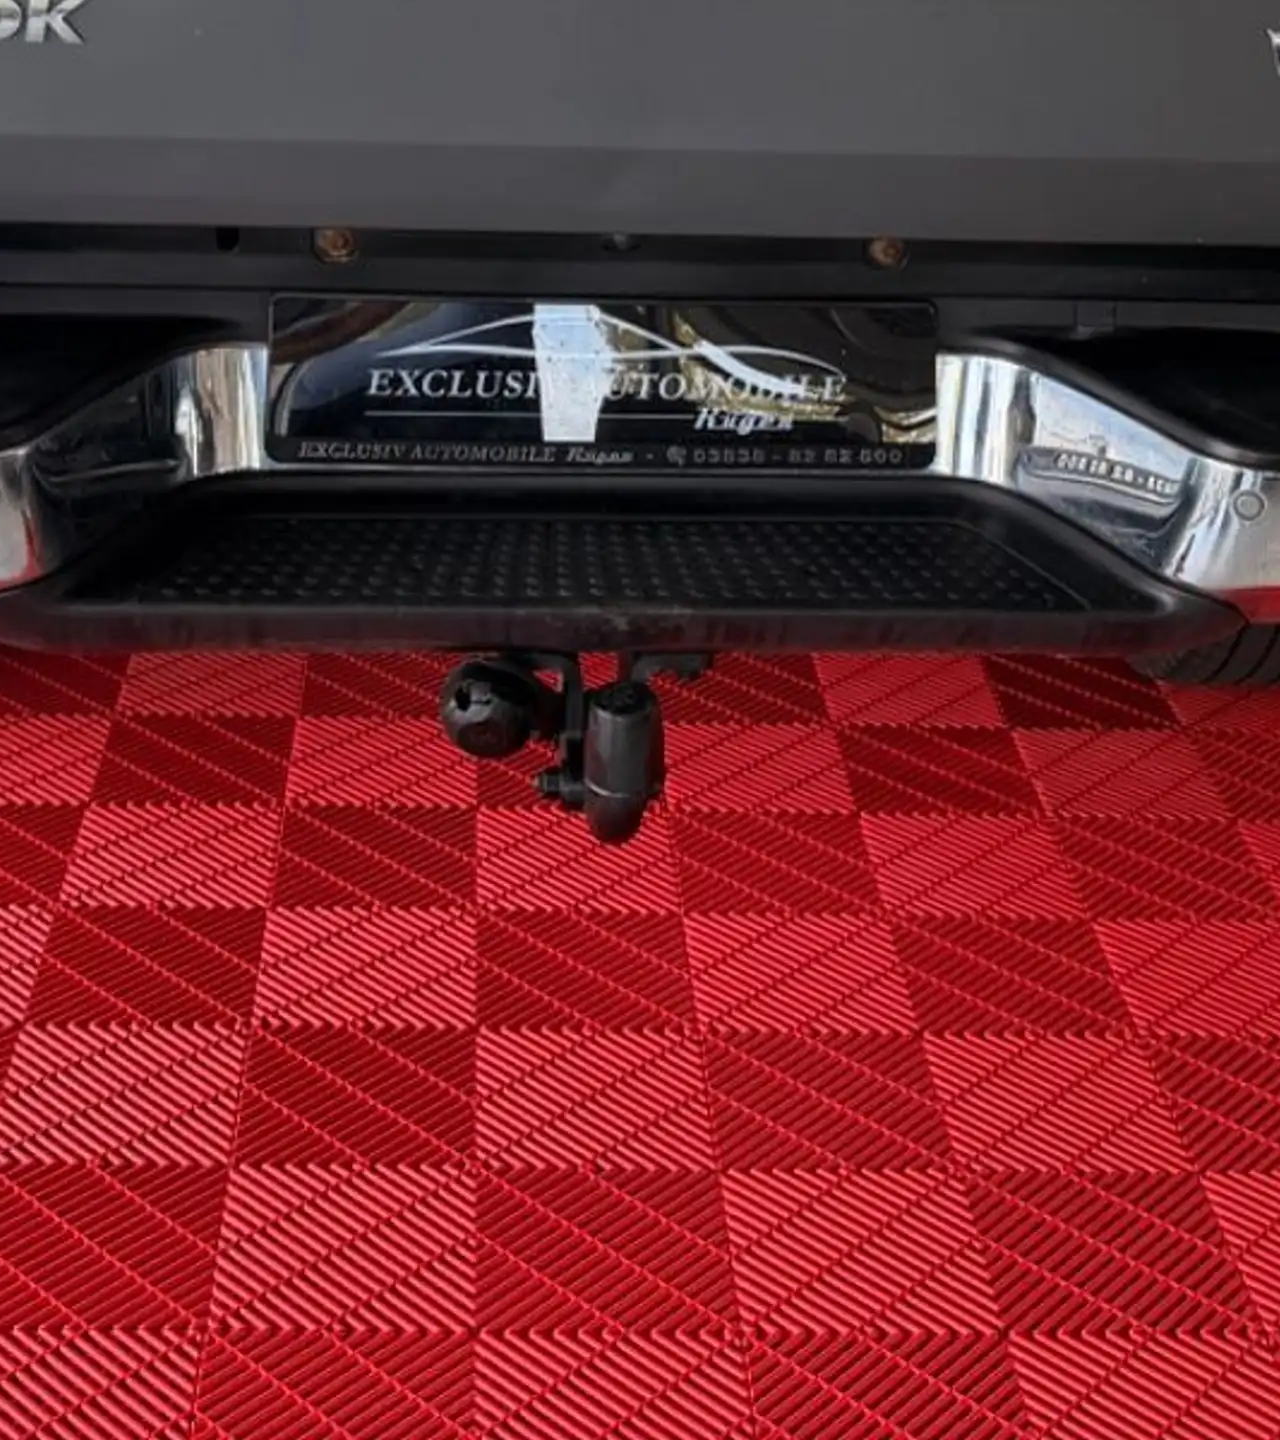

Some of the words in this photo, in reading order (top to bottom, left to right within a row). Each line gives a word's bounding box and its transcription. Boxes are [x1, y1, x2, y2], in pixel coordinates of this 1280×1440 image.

[367, 367, 566, 399] EXCLUSI
[298, 442, 406, 460] EXCLUSIV
[411, 444, 557, 462] AUTOMOBILE
